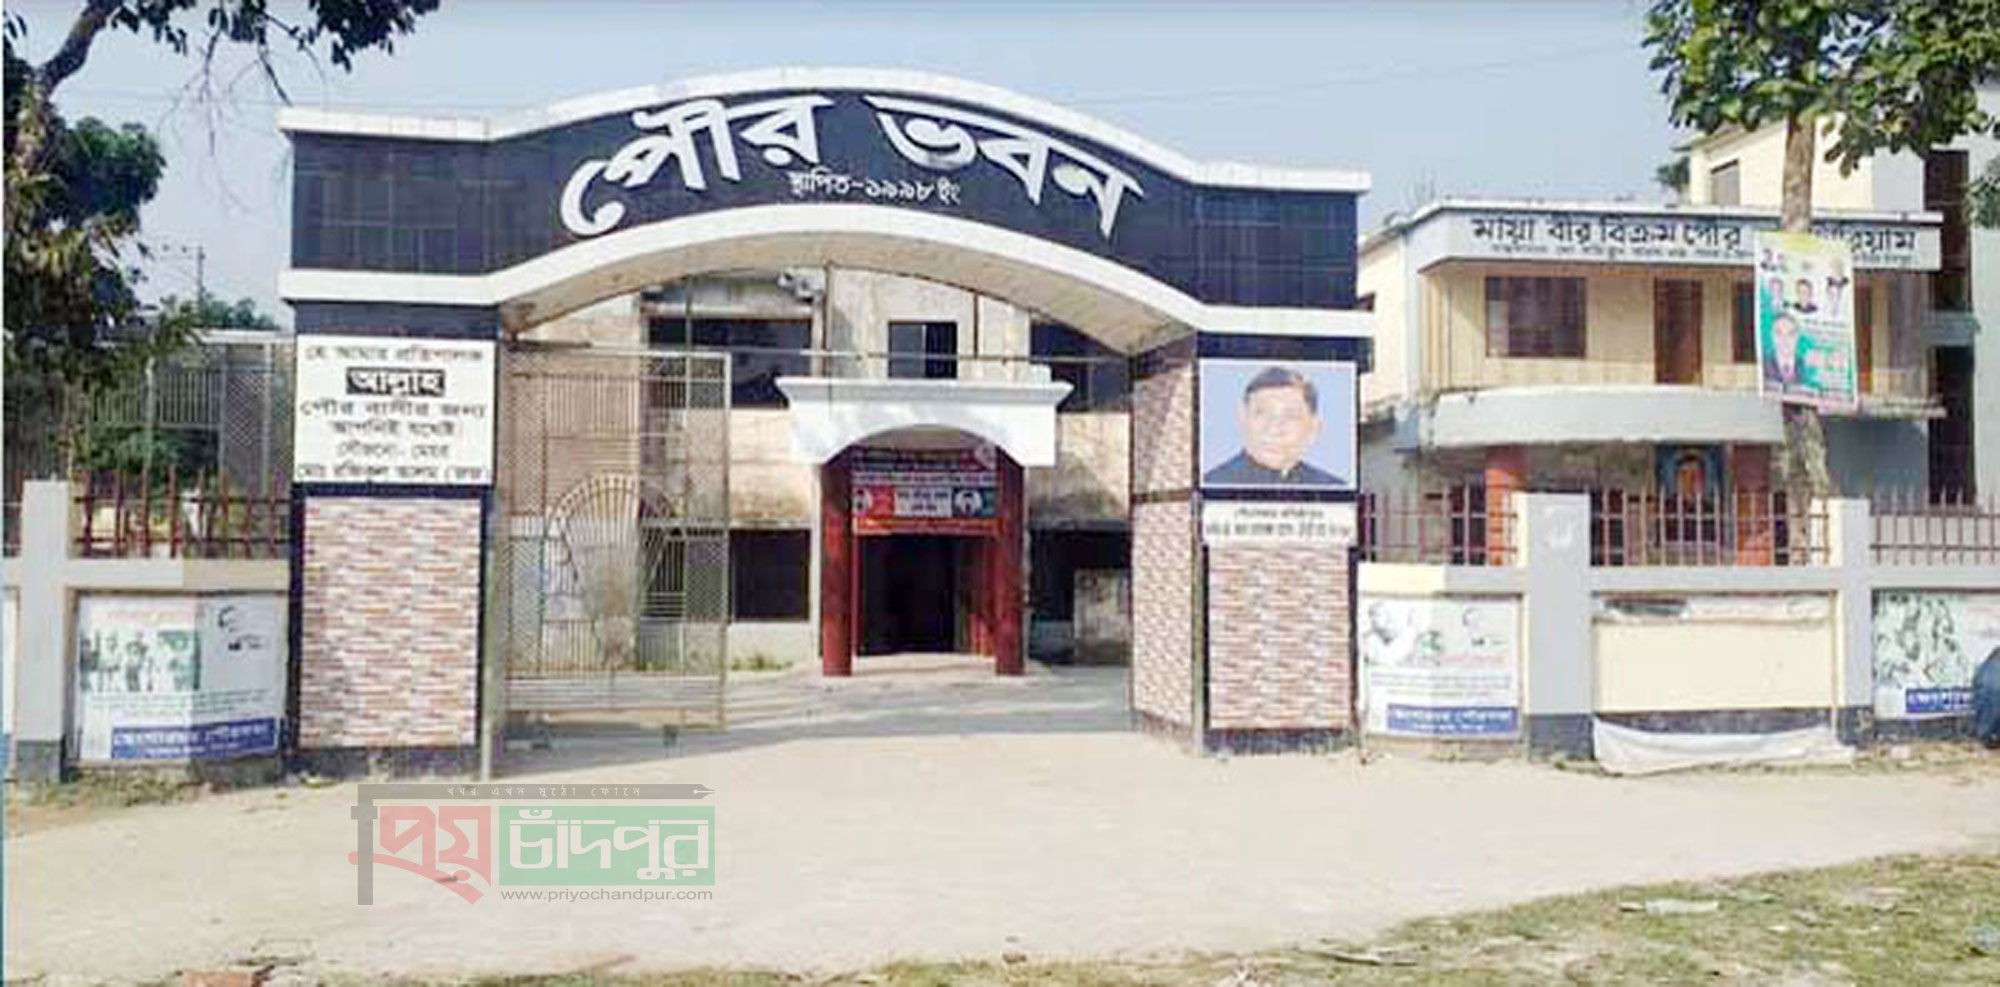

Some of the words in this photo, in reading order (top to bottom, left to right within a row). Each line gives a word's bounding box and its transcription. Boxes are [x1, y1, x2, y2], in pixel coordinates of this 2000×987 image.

[560, 97, 835, 236] পৌর
[864, 95, 1144, 238] ভবন
[1470, 217, 1536, 244] মায়া
[1600, 214, 1676, 243] বিক্রম
